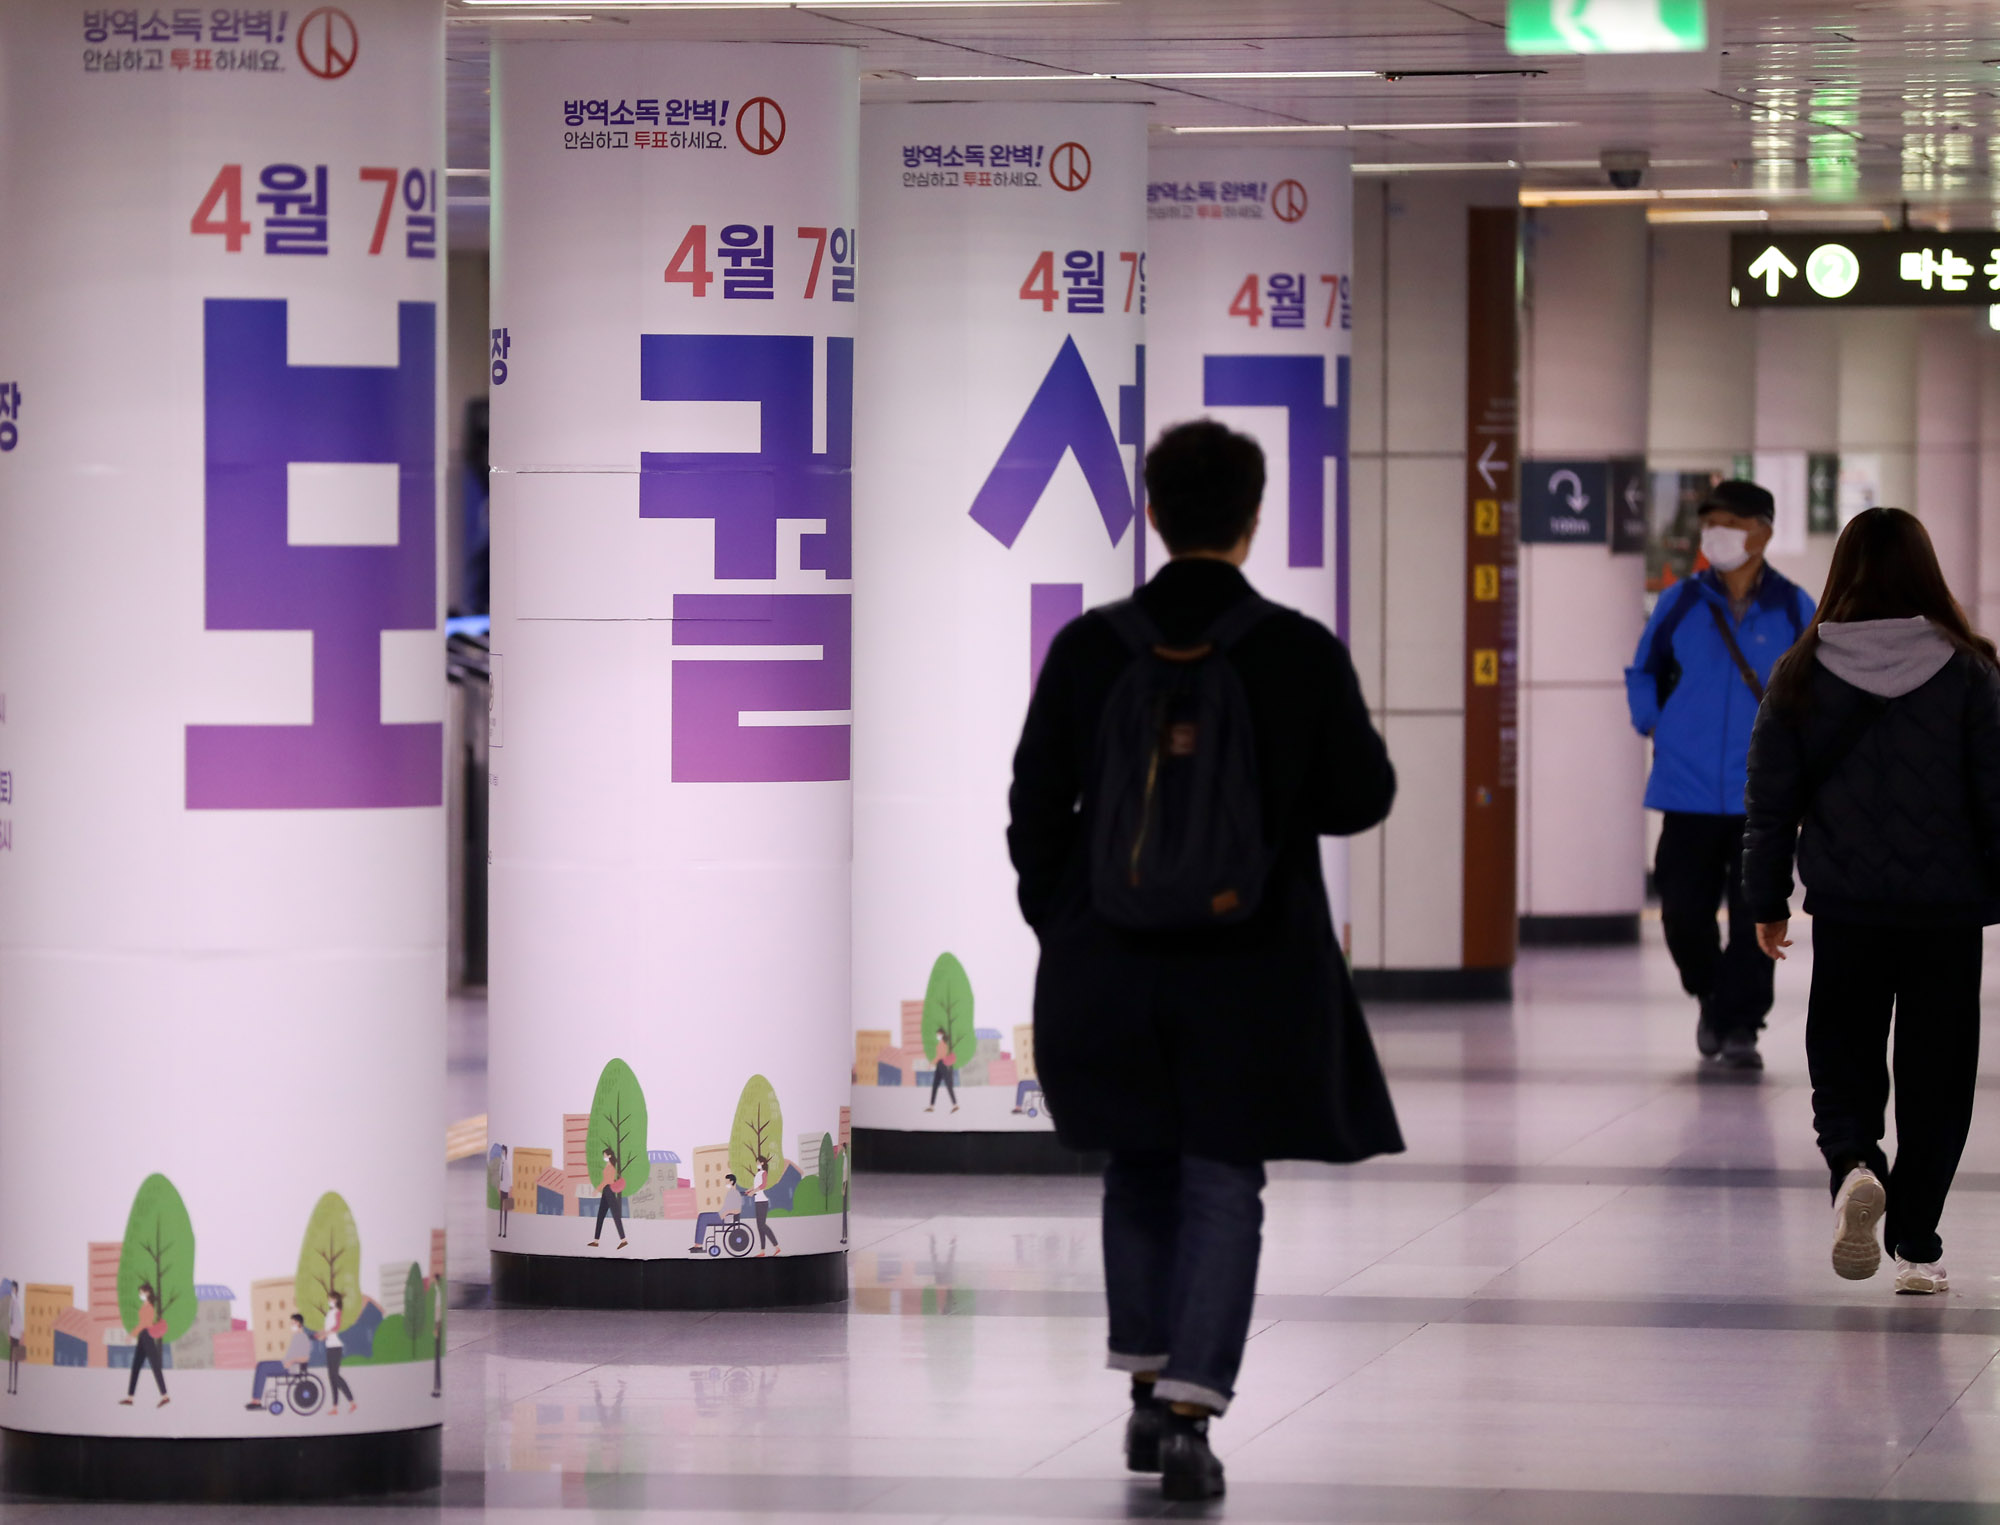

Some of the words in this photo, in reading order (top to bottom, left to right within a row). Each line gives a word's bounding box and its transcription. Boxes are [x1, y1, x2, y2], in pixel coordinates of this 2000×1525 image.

[84, 10, 203, 43] 방역소독
[209, 10, 288, 43] 완벽!
[83, 50, 163, 72] 안심하고
[170, 49, 286, 72] 투표하세요.
[564, 100, 660, 126] 방역소독
[665, 100, 729, 126] 완벽!
[564, 131, 628, 149] 안심하고
[634, 131, 727, 149] 투표하세요.
[903, 145, 984, 167] 방역소독
[990, 145, 1043, 167] 완벽!
[903, 172, 958, 187] 안심하고
[963, 171, 1042, 187] 투표하세요.
[190, 164, 329, 256] 4월
[359, 167, 436, 259] 7일
[664, 224, 774, 300] 4월
[797, 226, 855, 302] 7일
[1019, 250, 1104, 314] 4월
[1228, 273, 1305, 329] 4월
[185, 298, 442, 810] 보
[639, 334, 853, 783] 궐
